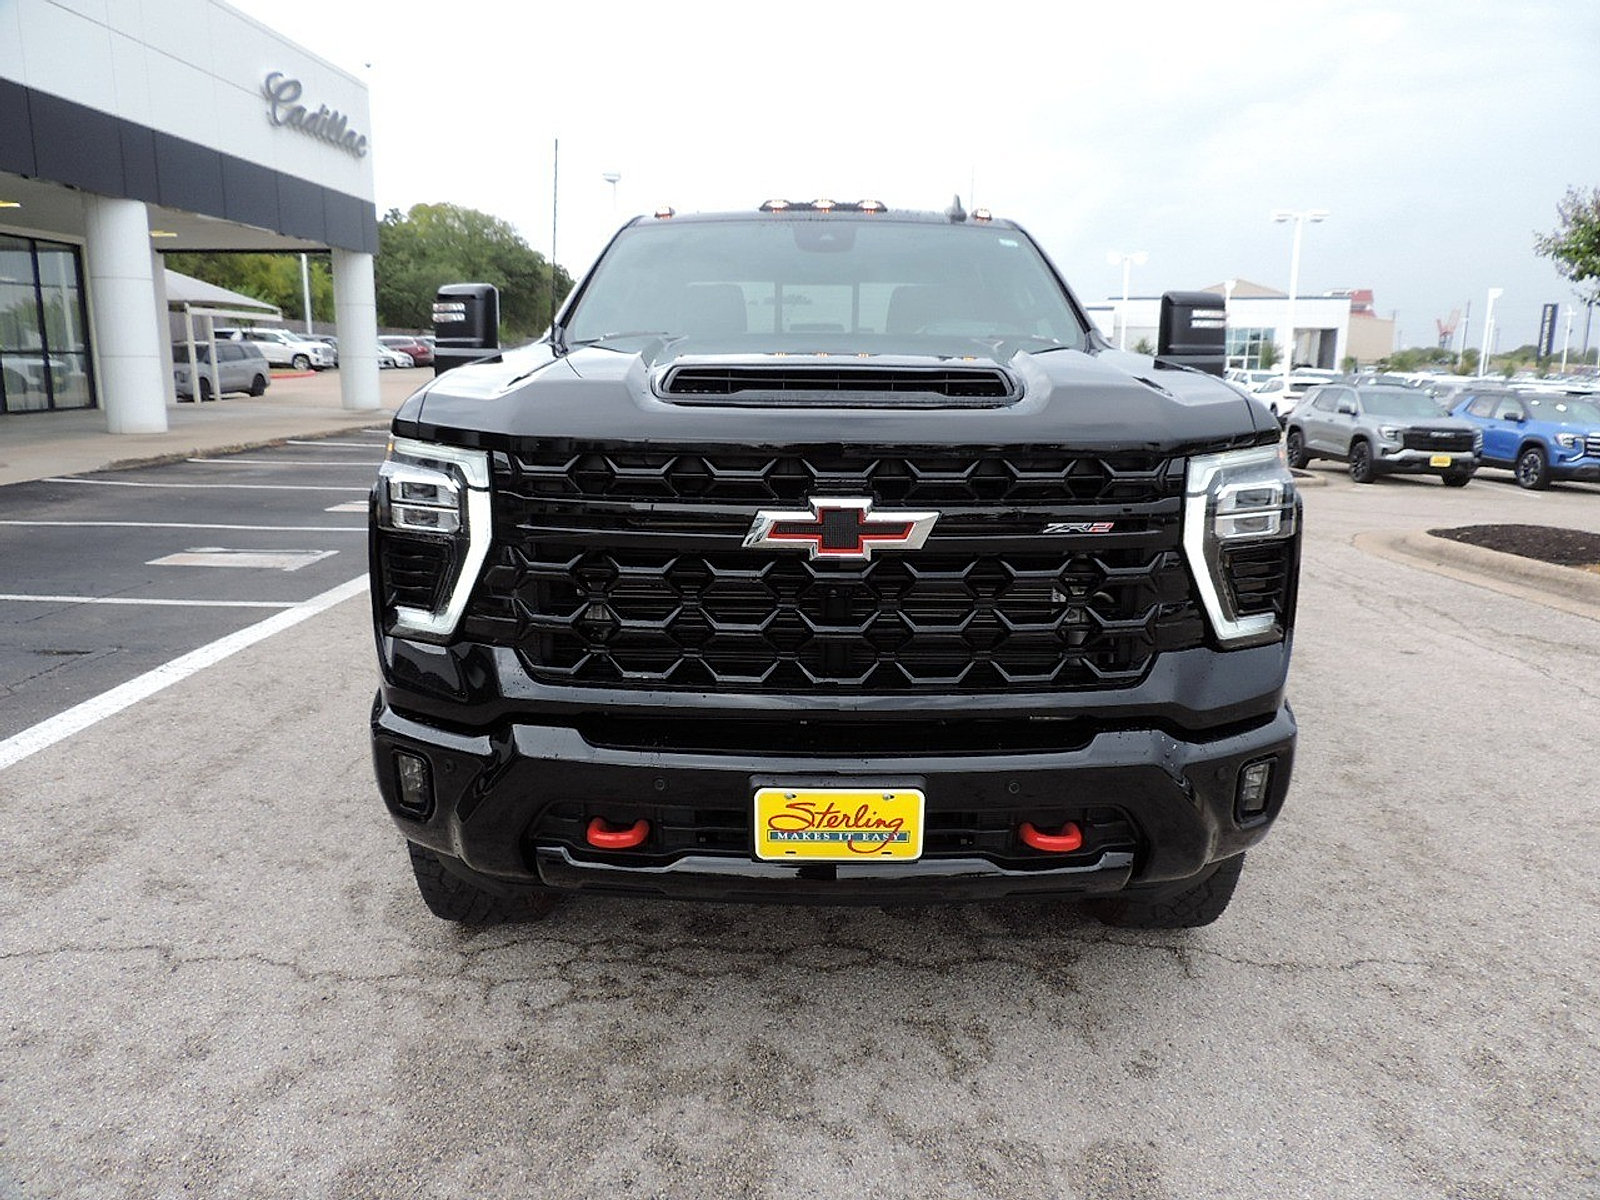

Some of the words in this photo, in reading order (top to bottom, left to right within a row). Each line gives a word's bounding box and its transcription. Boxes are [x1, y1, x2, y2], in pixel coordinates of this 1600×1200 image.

[264, 71, 367, 158] Cadillac
[1043, 522, 1115, 534] ZR2
[768, 802, 904, 854] Sterling
[777, 831, 831, 841] MAKES
[839, 832, 854, 841] IT
[862, 832, 900, 841] EASY
